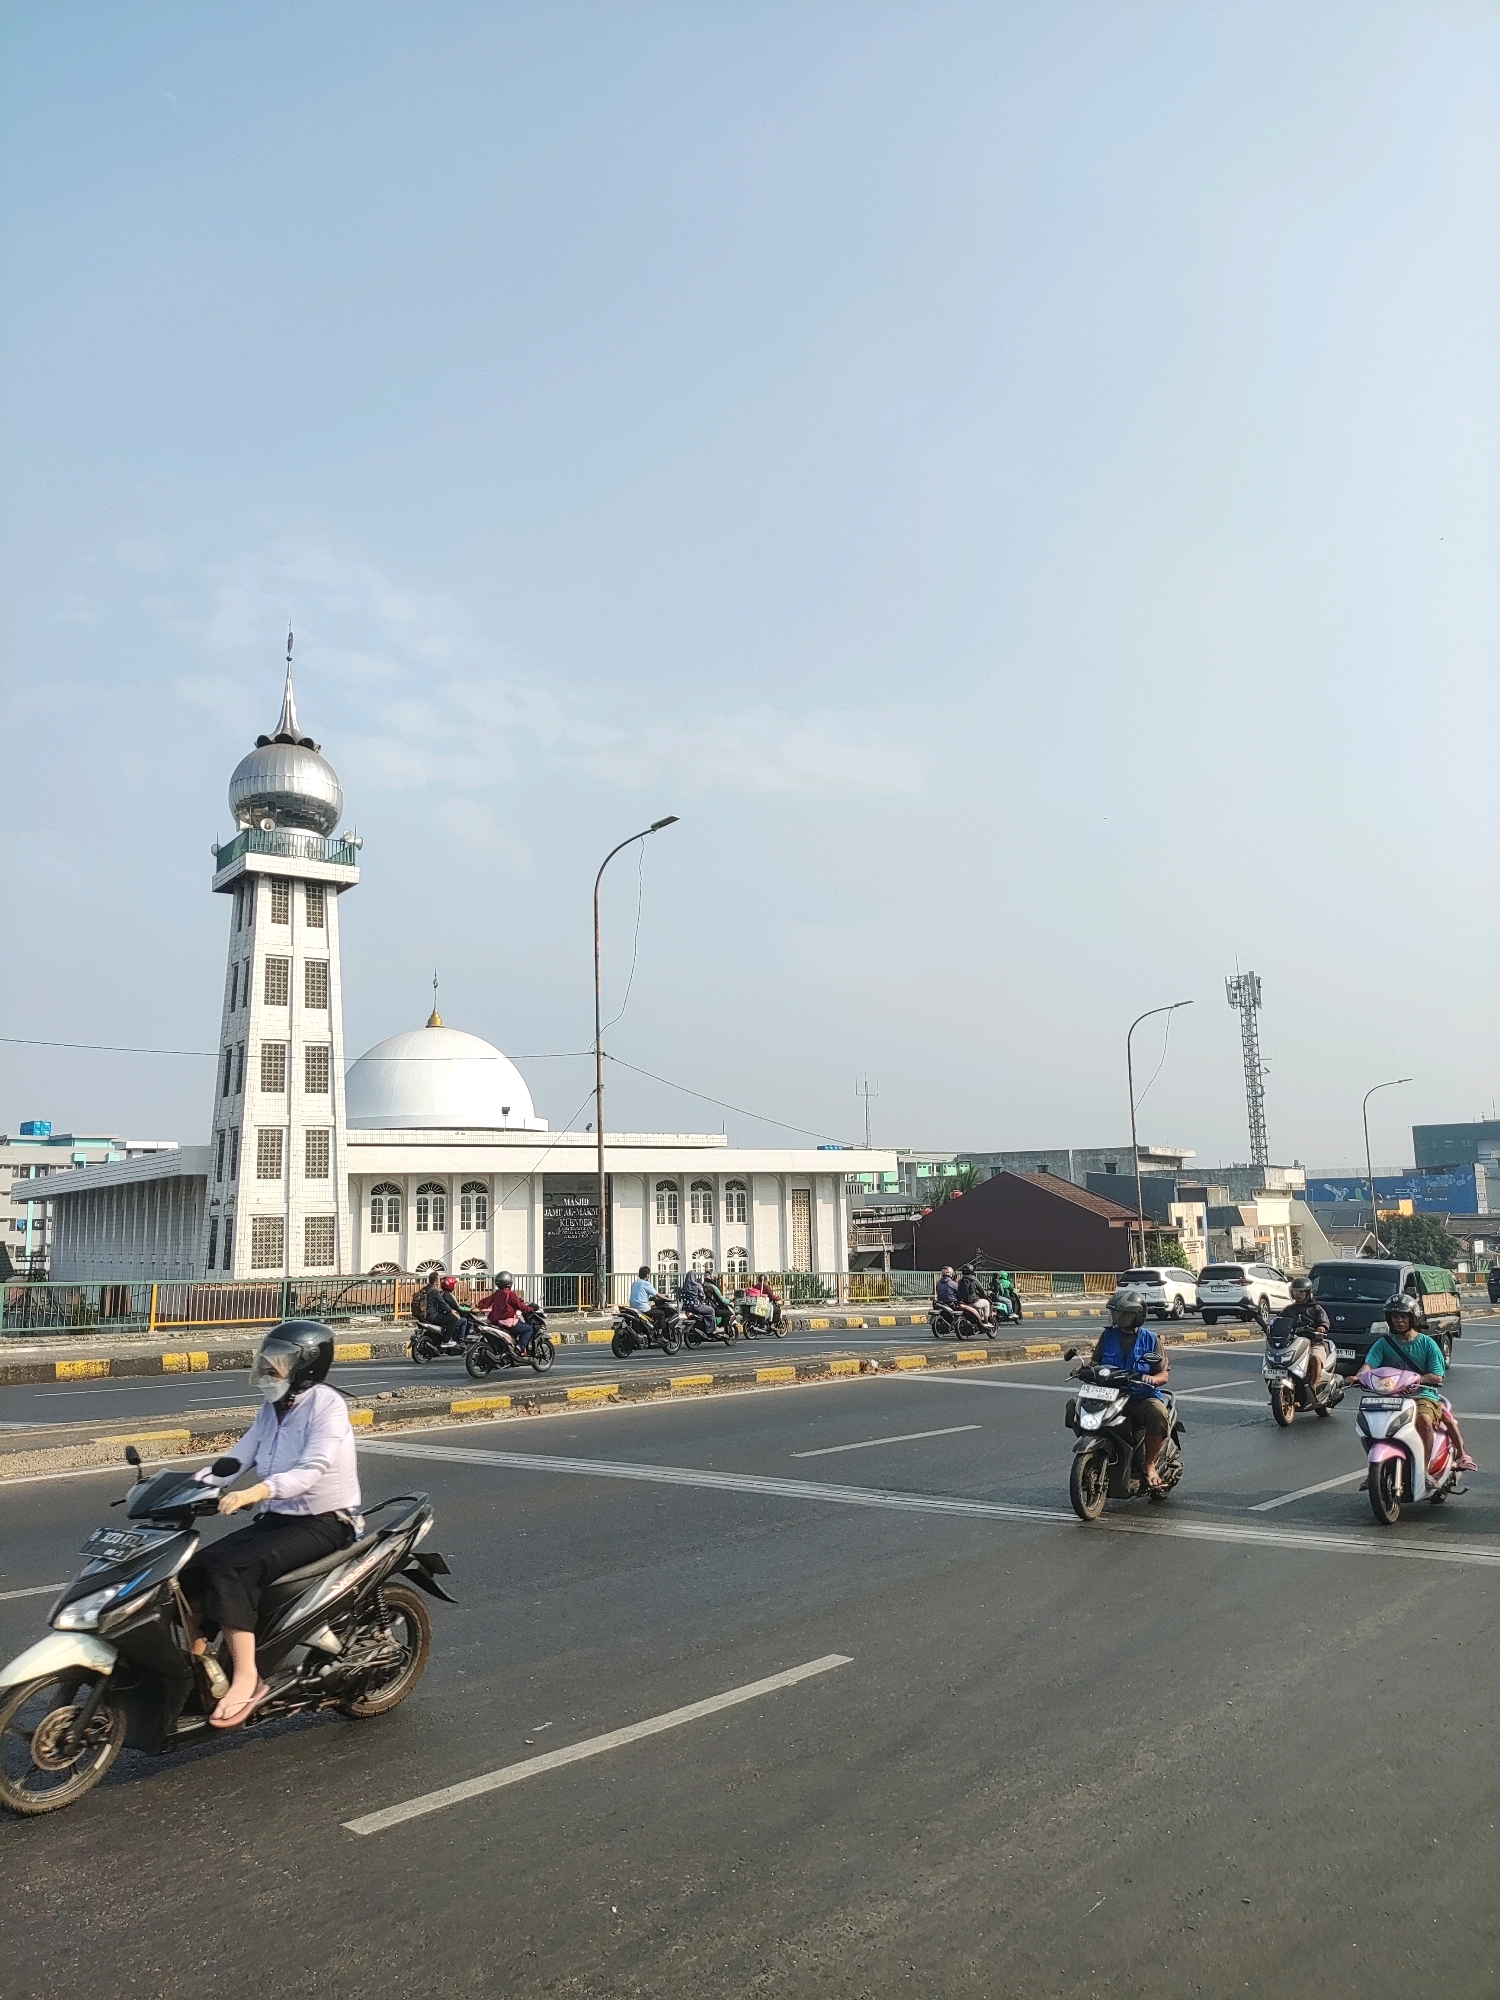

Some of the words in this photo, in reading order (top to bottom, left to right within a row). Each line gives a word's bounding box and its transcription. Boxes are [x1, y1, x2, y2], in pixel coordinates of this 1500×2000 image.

[563, 1197, 590, 1206] MASJID
[559, 1218, 593, 1227] KLENDER
[329, 1554, 377, 1591] VARIO
